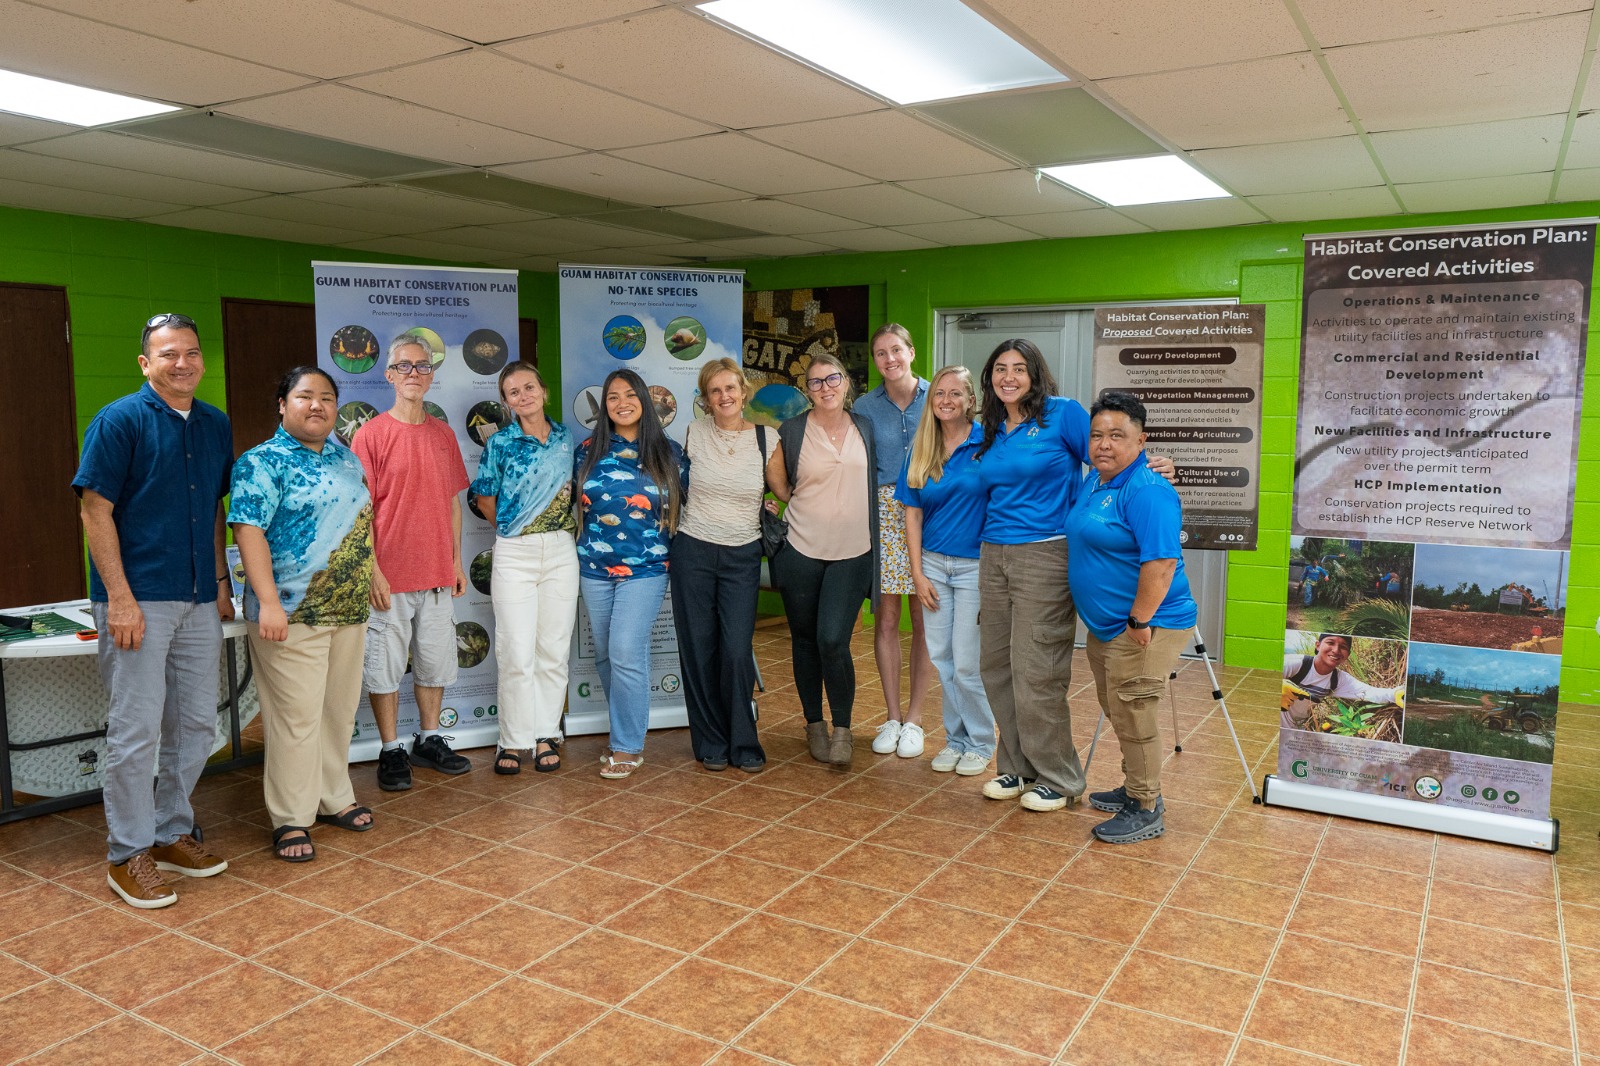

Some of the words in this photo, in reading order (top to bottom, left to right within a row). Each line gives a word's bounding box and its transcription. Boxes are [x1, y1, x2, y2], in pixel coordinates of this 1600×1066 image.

[1311, 240, 1383, 256] Habitat
[1389, 230, 1525, 252] Conservation
[1533, 228, 1587, 245] Plan:
[1348, 262, 1429, 280] Covered
[1434, 259, 1534, 277] Activities
[561, 270, 591, 279] GUAM
[595, 271, 637, 280] HABITAT
[641, 272, 714, 282] CONSERVATION
[718, 274, 741, 284] PLAN
[316, 276, 350, 287] GUAM
[354, 278, 401, 288] HABITAT
[405, 280, 487, 291] CONSERVATION
[490, 283, 516, 293] PLAN
[608, 286, 653, 296] NO-TAKE
[657, 288, 698, 297] SPECIES
[369, 294, 421, 305] COVERED
[425, 296, 469, 307] SPECIES
[1343, 296, 1420, 308] Operations
[1427, 295, 1435, 304] &
[1441, 292, 1540, 304] Maintenance
[1107, 313, 1146, 322] Habitat
[1149, 312, 1219, 321] Conservation
[1222, 311, 1249, 319] Plan:
[1313, 316, 1366, 327] Activities
[1369, 316, 1381, 326] to
[1385, 315, 1432, 327] operate
[1436, 314, 1459, 324] and
[1464, 313, 1519, 323] maintain
[1523, 311, 1575, 323] existing
[1102, 328, 1154, 338] Proposed
[1155, 327, 1198, 335] Covered
[1201, 326, 1252, 335] Activities
[1334, 333, 1367, 344] utility
[1372, 331, 1422, 342] facilities
[1426, 330, 1449, 341] and
[1452, 329, 1543, 339] infrastructure
[1334, 352, 1418, 363] Commercial
[1423, 352, 1449, 362] and
[1455, 350, 1539, 361] Residential
[1386, 369, 1484, 381] Development
[1324, 391, 1400, 400] Construction
[1404, 391, 1454, 402] projects
[1459, 391, 1533, 400] undertaken
[1537, 392, 1550, 400] to
[1350, 406, 1402, 416] facilitate
[1405, 407, 1465, 416] economic
[1469, 407, 1514, 418] growth
[1193, 431, 1240, 439] Agriculture
[1315, 426, 1344, 435] New
[1349, 426, 1409, 436] Facilities
[1415, 428, 1440, 437] and
[1446, 428, 1551, 439] Infrastructure
[1336, 446, 1361, 455] New
[1365, 446, 1398, 458] utility
[1402, 447, 1452, 458] projects
[1456, 449, 1528, 460] anticipated
[1364, 462, 1390, 471] over
[1394, 462, 1413, 472] the
[1417, 464, 1457, 474] permit
[1461, 465, 1491, 474] term
[1354, 480, 1382, 490] HCP
[1387, 481, 1501, 494] Implementation
[1325, 498, 1402, 510] Conservation
[1405, 502, 1456, 512] projects
[1459, 503, 1513, 515] required
[1517, 506, 1531, 515] to
[1319, 513, 1370, 523] establish
[1373, 515, 1393, 524] the
[1396, 516, 1421, 525] HCP
[1426, 517, 1474, 529] Reserve
[1479, 520, 1532, 532] Network
[1390, 783, 1406, 792] ICF
